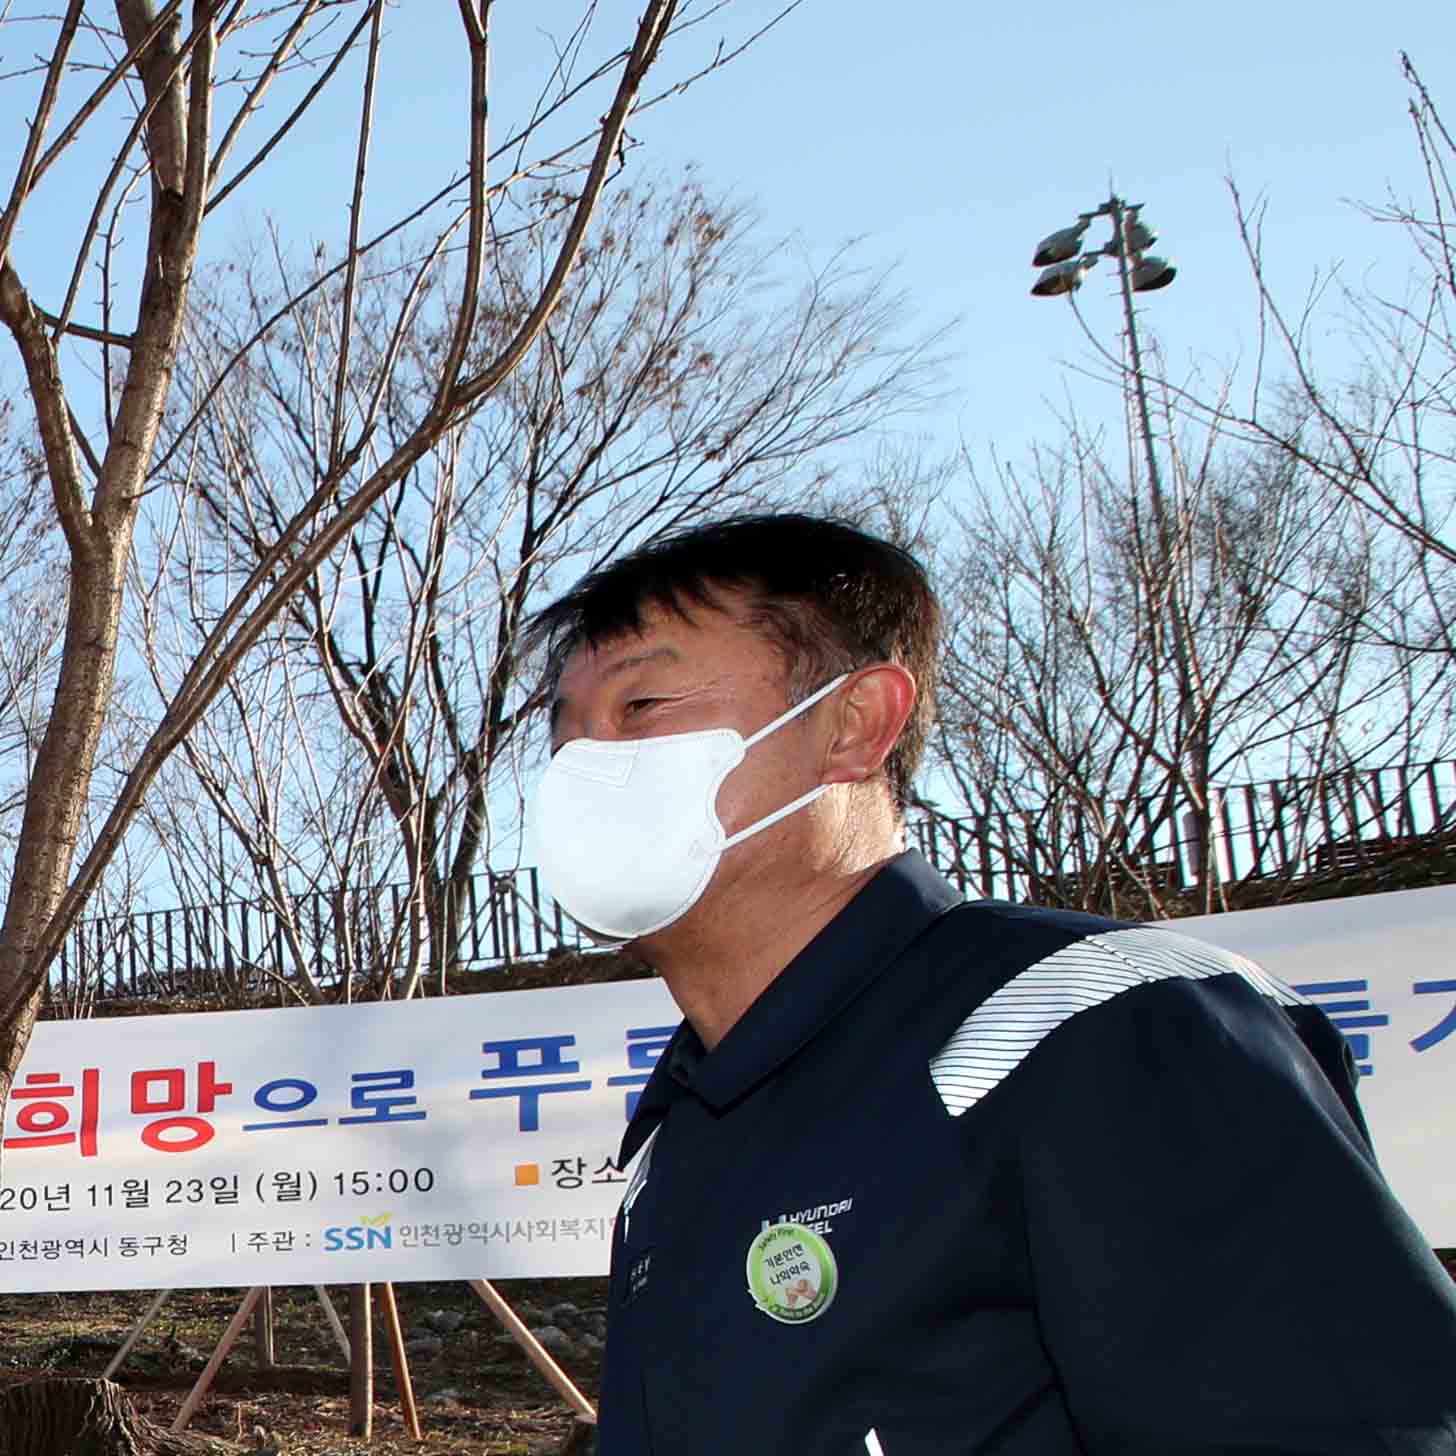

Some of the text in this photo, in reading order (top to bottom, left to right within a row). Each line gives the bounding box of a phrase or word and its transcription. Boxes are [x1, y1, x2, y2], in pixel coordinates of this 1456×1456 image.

[3, 1060, 429, 1157] 희망으로
[551, 1156, 628, 1190] 장소
[0, 1183, 71, 1212] 20년
[87, 1179, 150, 1209] 11월
[165, 1174, 240, 1206] 23일
[255, 1170, 318, 1203] (월)
[333, 1167, 435, 1196] 15:00
[789, 1197, 854, 1224] HYUNDAI
[118, 1234, 189, 1258] 동구청
[247, 1230, 296, 1253] 주관
[323, 1225, 393, 1252] SSN
